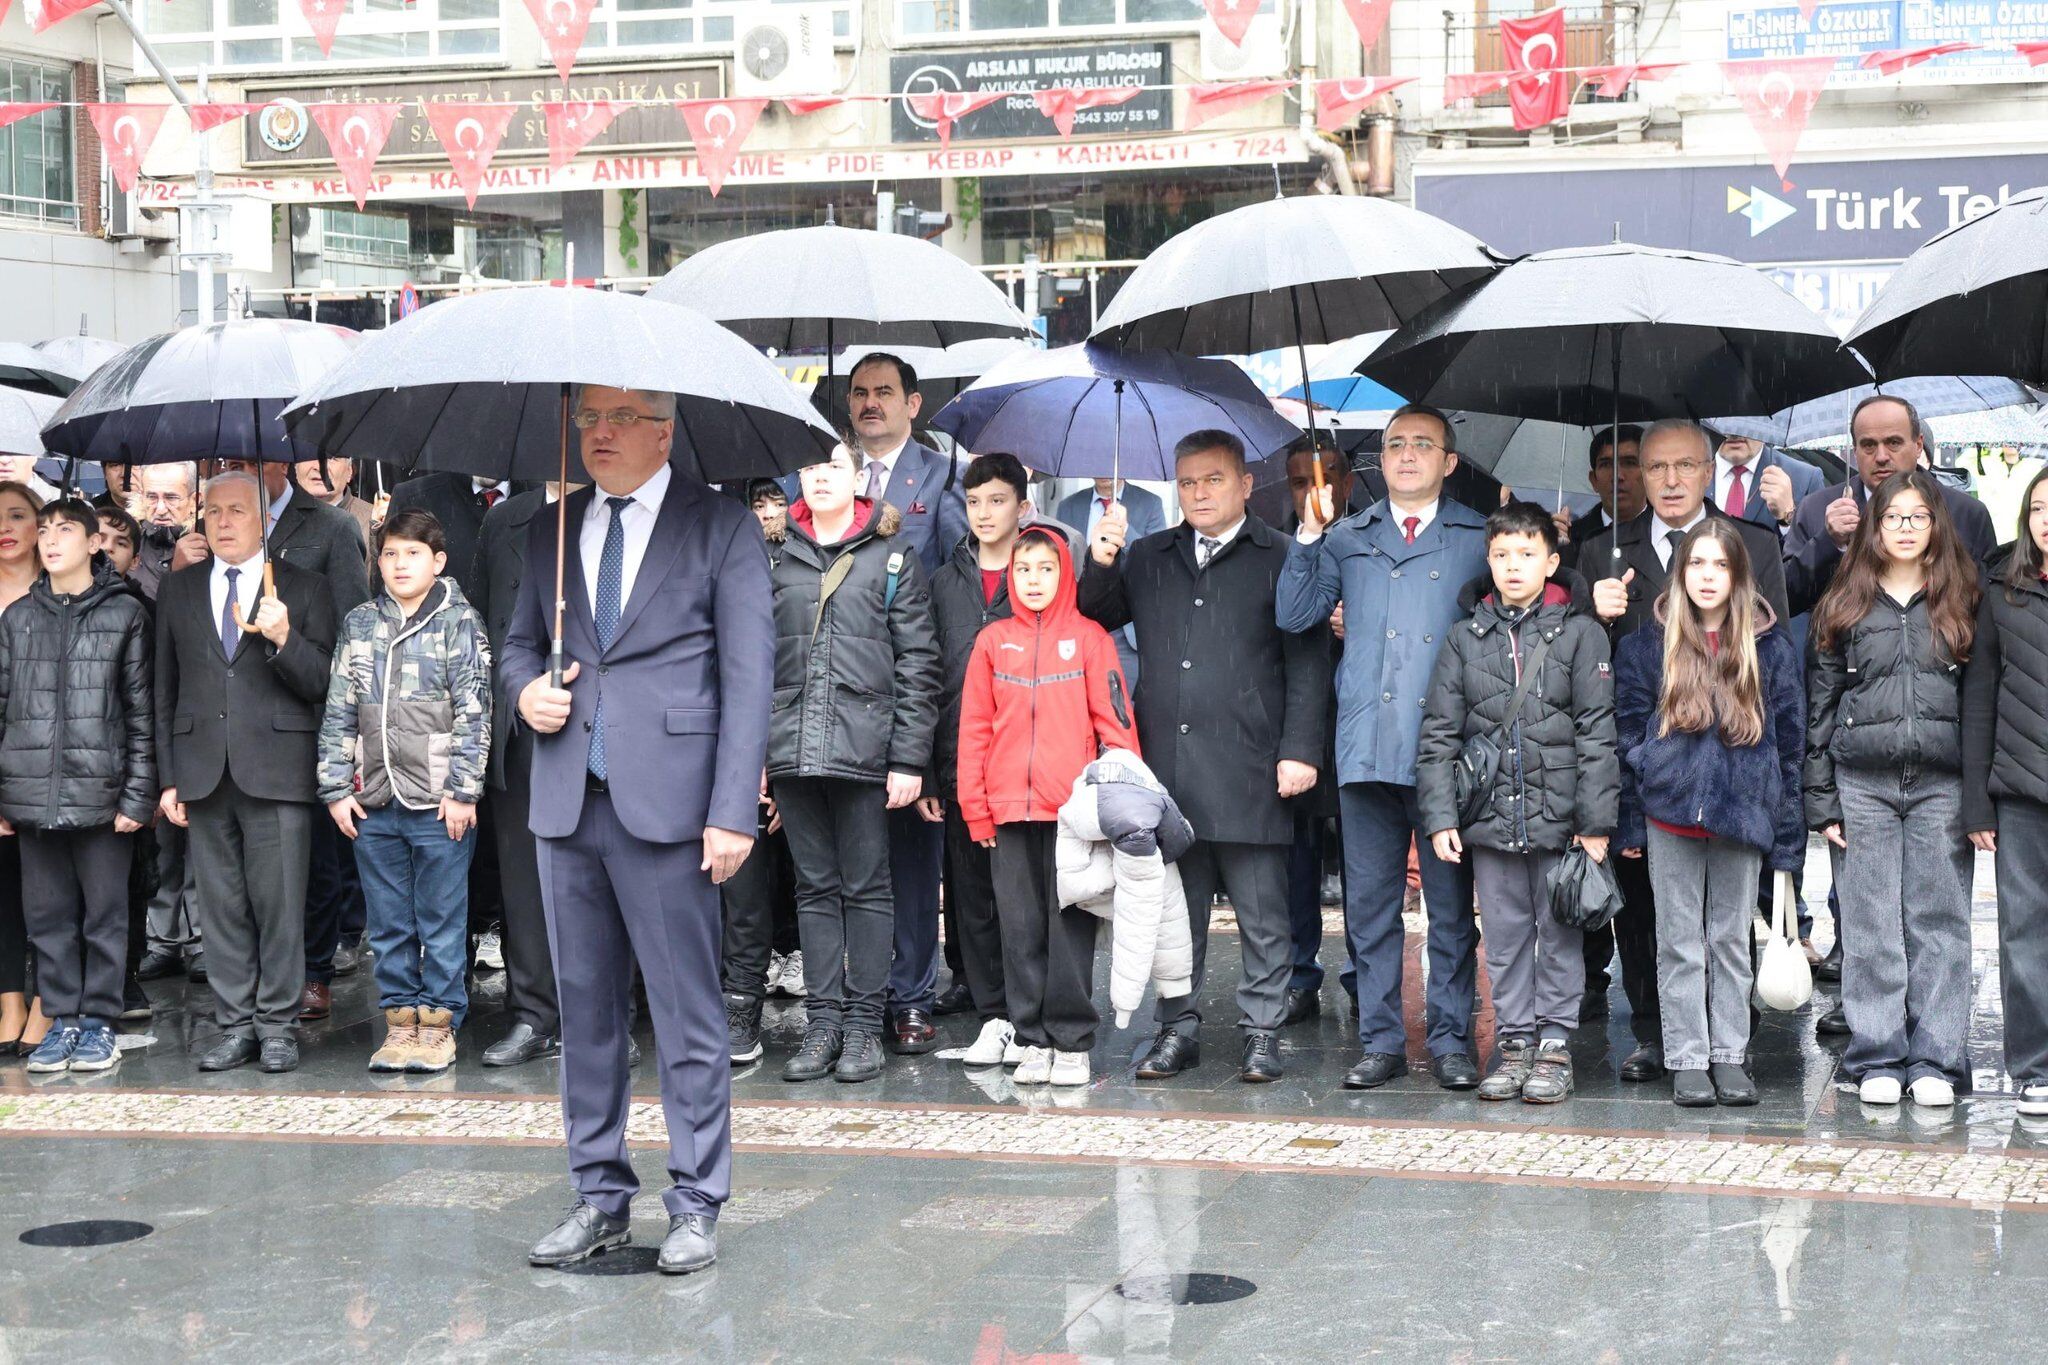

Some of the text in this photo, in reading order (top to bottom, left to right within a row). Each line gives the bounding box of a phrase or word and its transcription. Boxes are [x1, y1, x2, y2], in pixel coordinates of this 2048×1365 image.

[1756, 8, 1890, 36] SİNEM ÖZKURT
[966, 51, 1162, 78] ARSLAN HUKUK BÜROSU
[978, 79, 1038, 93] AVUKAT
[1052, 74, 1145, 90] ARABULUCU
[1103, 111, 1126, 123] 307
[1128, 110, 1144, 121] 55
[1146, 109, 1160, 120] 19
[313, 174, 392, 195] KEAP
[430, 167, 550, 190] KAVALTI
[592, 156, 666, 181] ANIT
[928, 149, 1013, 171] KEBAP
[1057, 143, 1189, 164] KAHVALTI
[1234, 137, 1287, 157] 7/24
[1806, 186, 1922, 231] Türk
